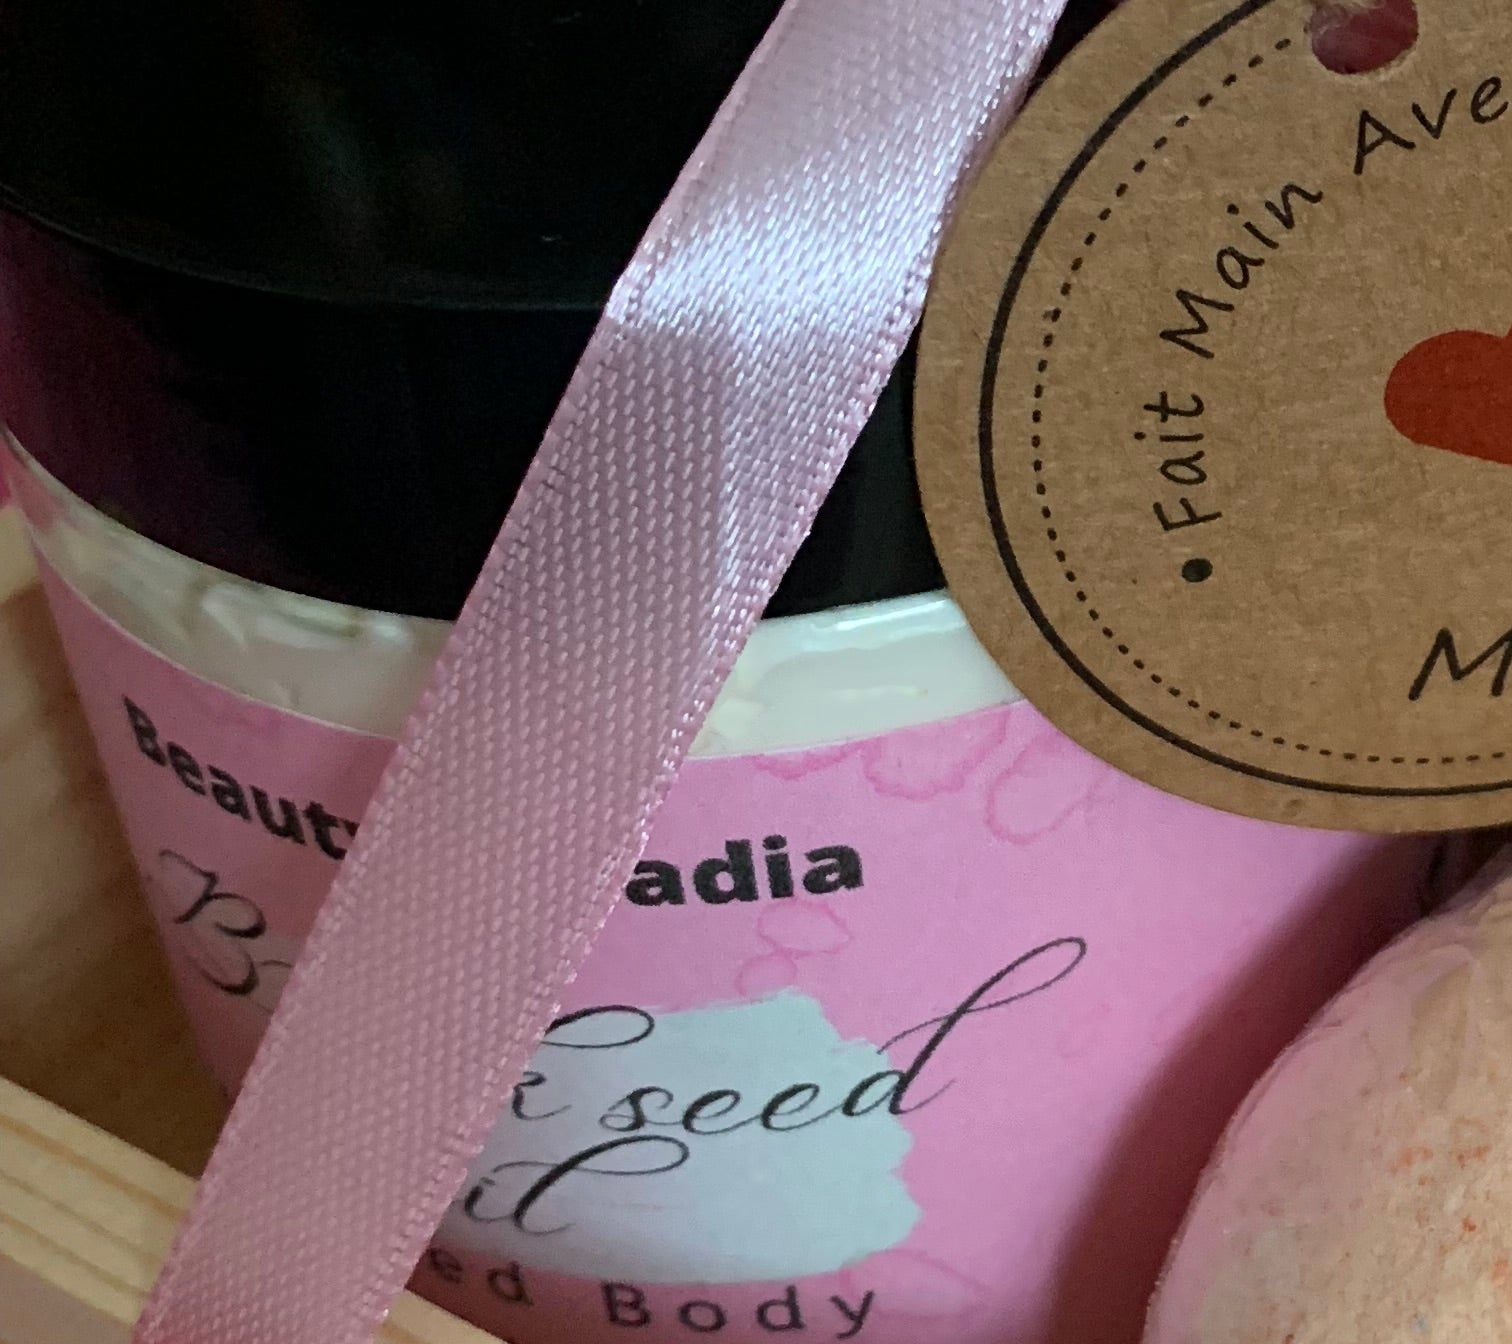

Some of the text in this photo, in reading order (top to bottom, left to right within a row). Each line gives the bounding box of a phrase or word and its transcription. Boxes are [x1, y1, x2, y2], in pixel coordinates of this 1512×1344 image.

[1159, 181, 1323, 359] Main
[1133, 389, 1223, 533] Fait
[599, 937, 1087, 1135] seed
[463, 1135, 690, 1235] il
[602, 1280, 875, 1340] Body
